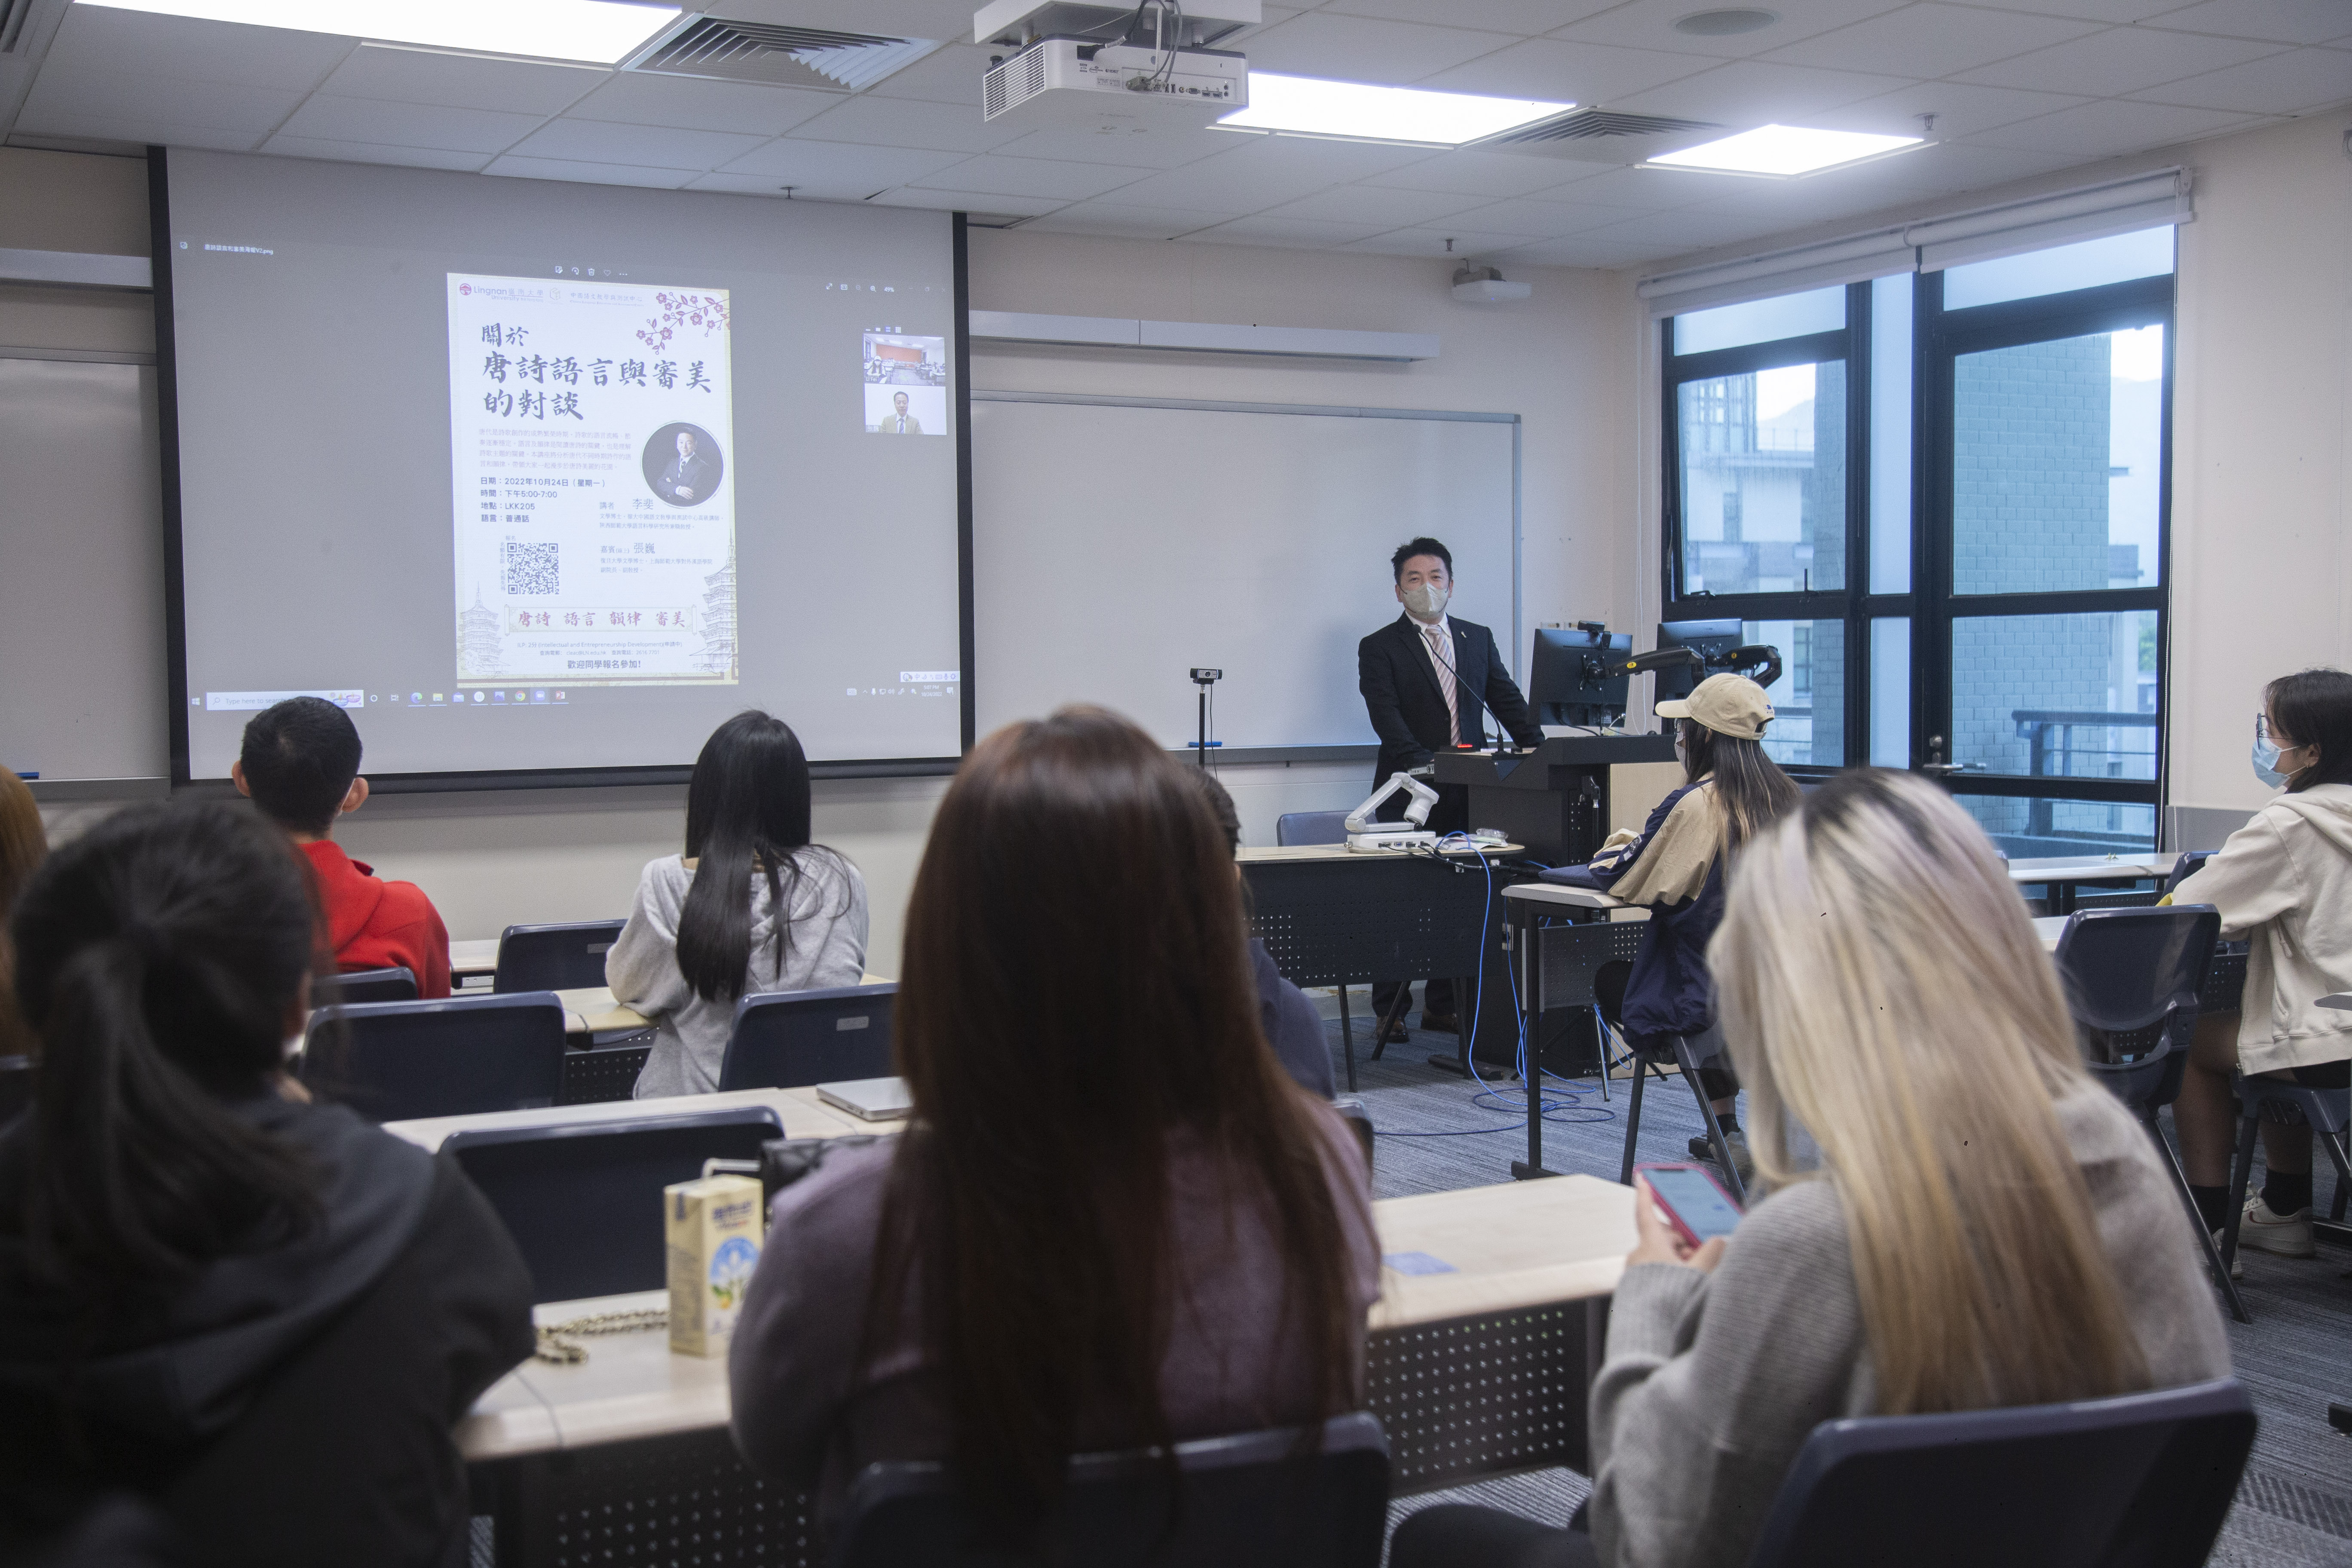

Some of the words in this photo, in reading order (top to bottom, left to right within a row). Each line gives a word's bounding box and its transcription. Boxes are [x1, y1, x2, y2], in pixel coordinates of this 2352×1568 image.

[474, 286, 507, 296] Lingnan
[481, 322, 529, 347] 關於
[482, 350, 711, 393] 唐詩語言與審美
[483, 389, 583, 420] 的對談
[599, 502, 615, 510] 講者
[632, 498, 654, 510] 李斐
[518, 610, 551, 628] 唐詩
[563, 611, 596, 627] 語言
[609, 611, 642, 628] 韻律
[655, 611, 686, 628] 審美
